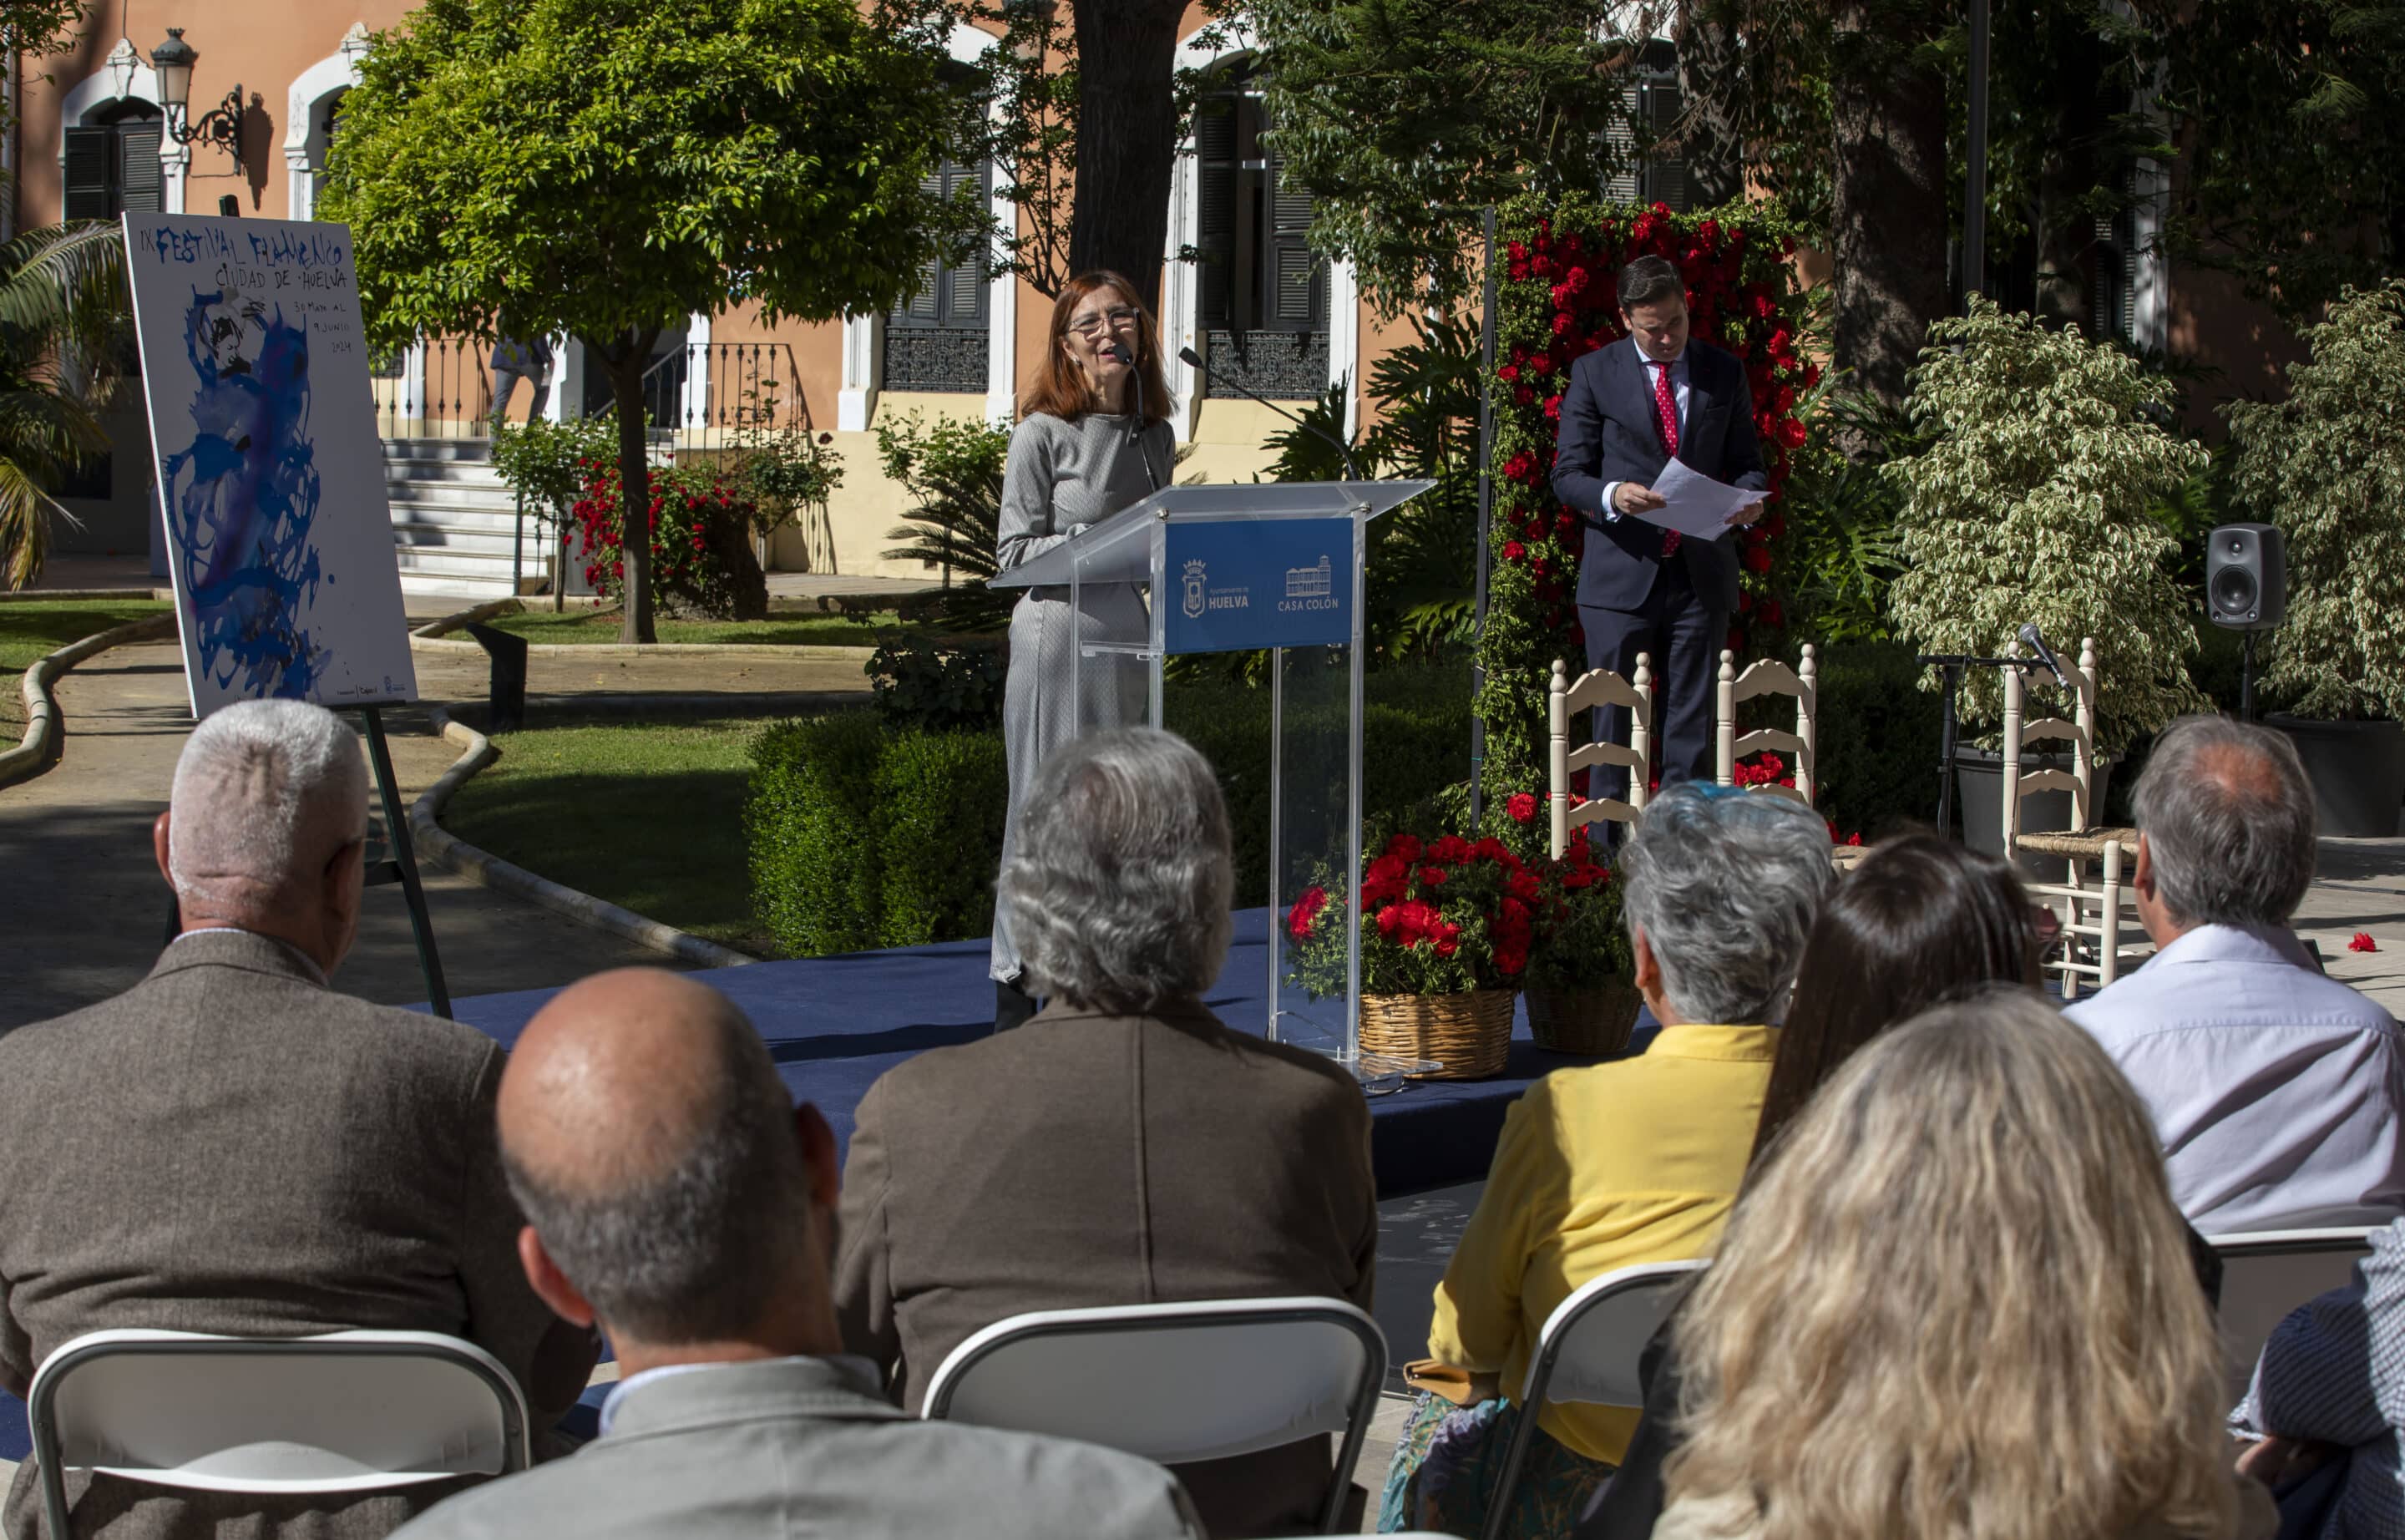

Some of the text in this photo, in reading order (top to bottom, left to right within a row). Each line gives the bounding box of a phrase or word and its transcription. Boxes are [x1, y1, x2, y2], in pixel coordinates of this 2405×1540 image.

[140, 226, 342, 270] IX FESTIVAL FLAMENCO
[215, 263, 347, 290] CIUDAD DE HUELVA
[294, 301, 306, 312] 30
[333, 303, 347, 312] AL
[332, 341, 352, 354] 2024
[1208, 595, 1249, 609] HUELVA
[1278, 595, 1339, 611] CASA COLÓN
